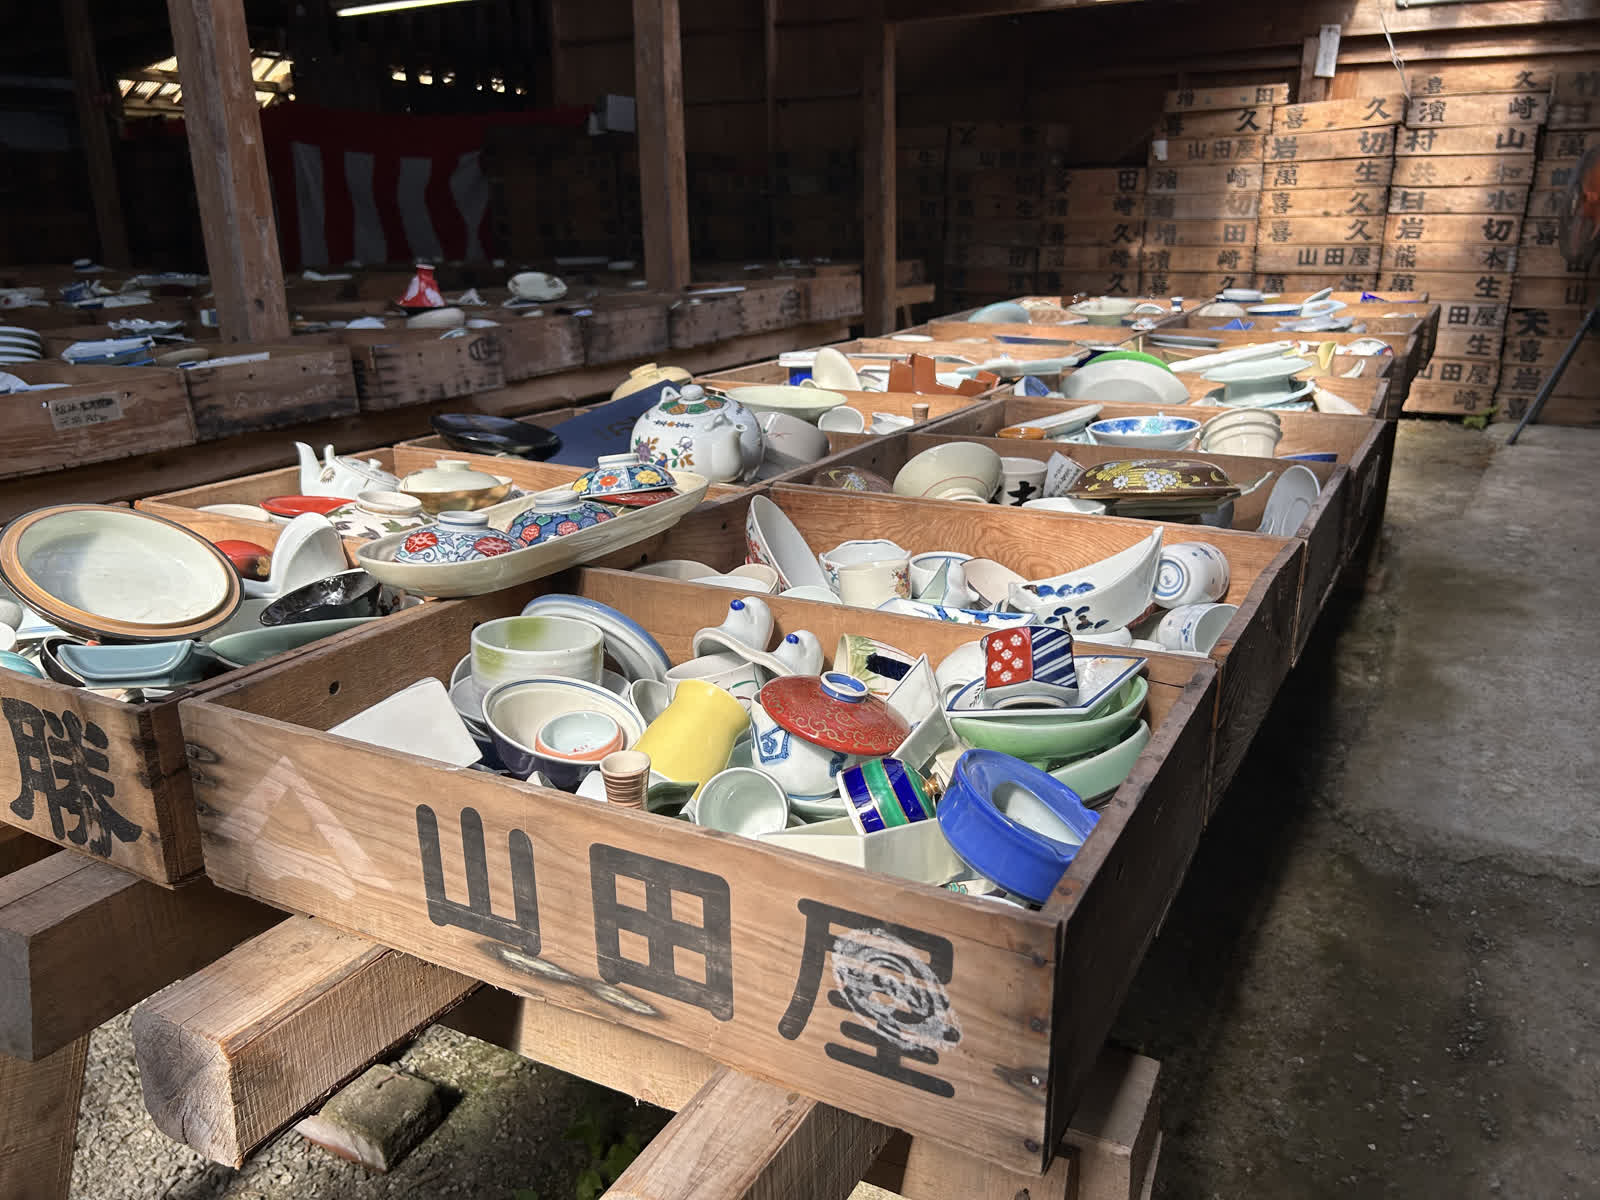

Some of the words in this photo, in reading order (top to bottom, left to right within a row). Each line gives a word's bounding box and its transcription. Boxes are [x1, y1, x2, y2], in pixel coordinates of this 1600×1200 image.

[1515, 71, 1537, 89] 久
[1362, 97, 1391, 120] 久
[1235, 109, 1260, 132] 久
[1357, 131, 1387, 154] 切
[1404, 129, 1437, 153] 村
[1496, 127, 1526, 150] 山
[1355, 161, 1381, 182] 生
[1346, 191, 1371, 214] 久
[1112, 223, 1133, 243] 久
[1224, 223, 1246, 243] 田
[1344, 219, 1372, 241] 久
[1395, 217, 1424, 240] 岩
[1482, 218, 1514, 241] 切
[1298, 247, 1370, 266] 山田屋
[1106, 272, 1129, 294] 久
[1474, 276, 1502, 299] 生
[1465, 334, 1492, 356] 生
[1, 696, 143, 859] 勝
[415, 803, 956, 1098] 山田屋
